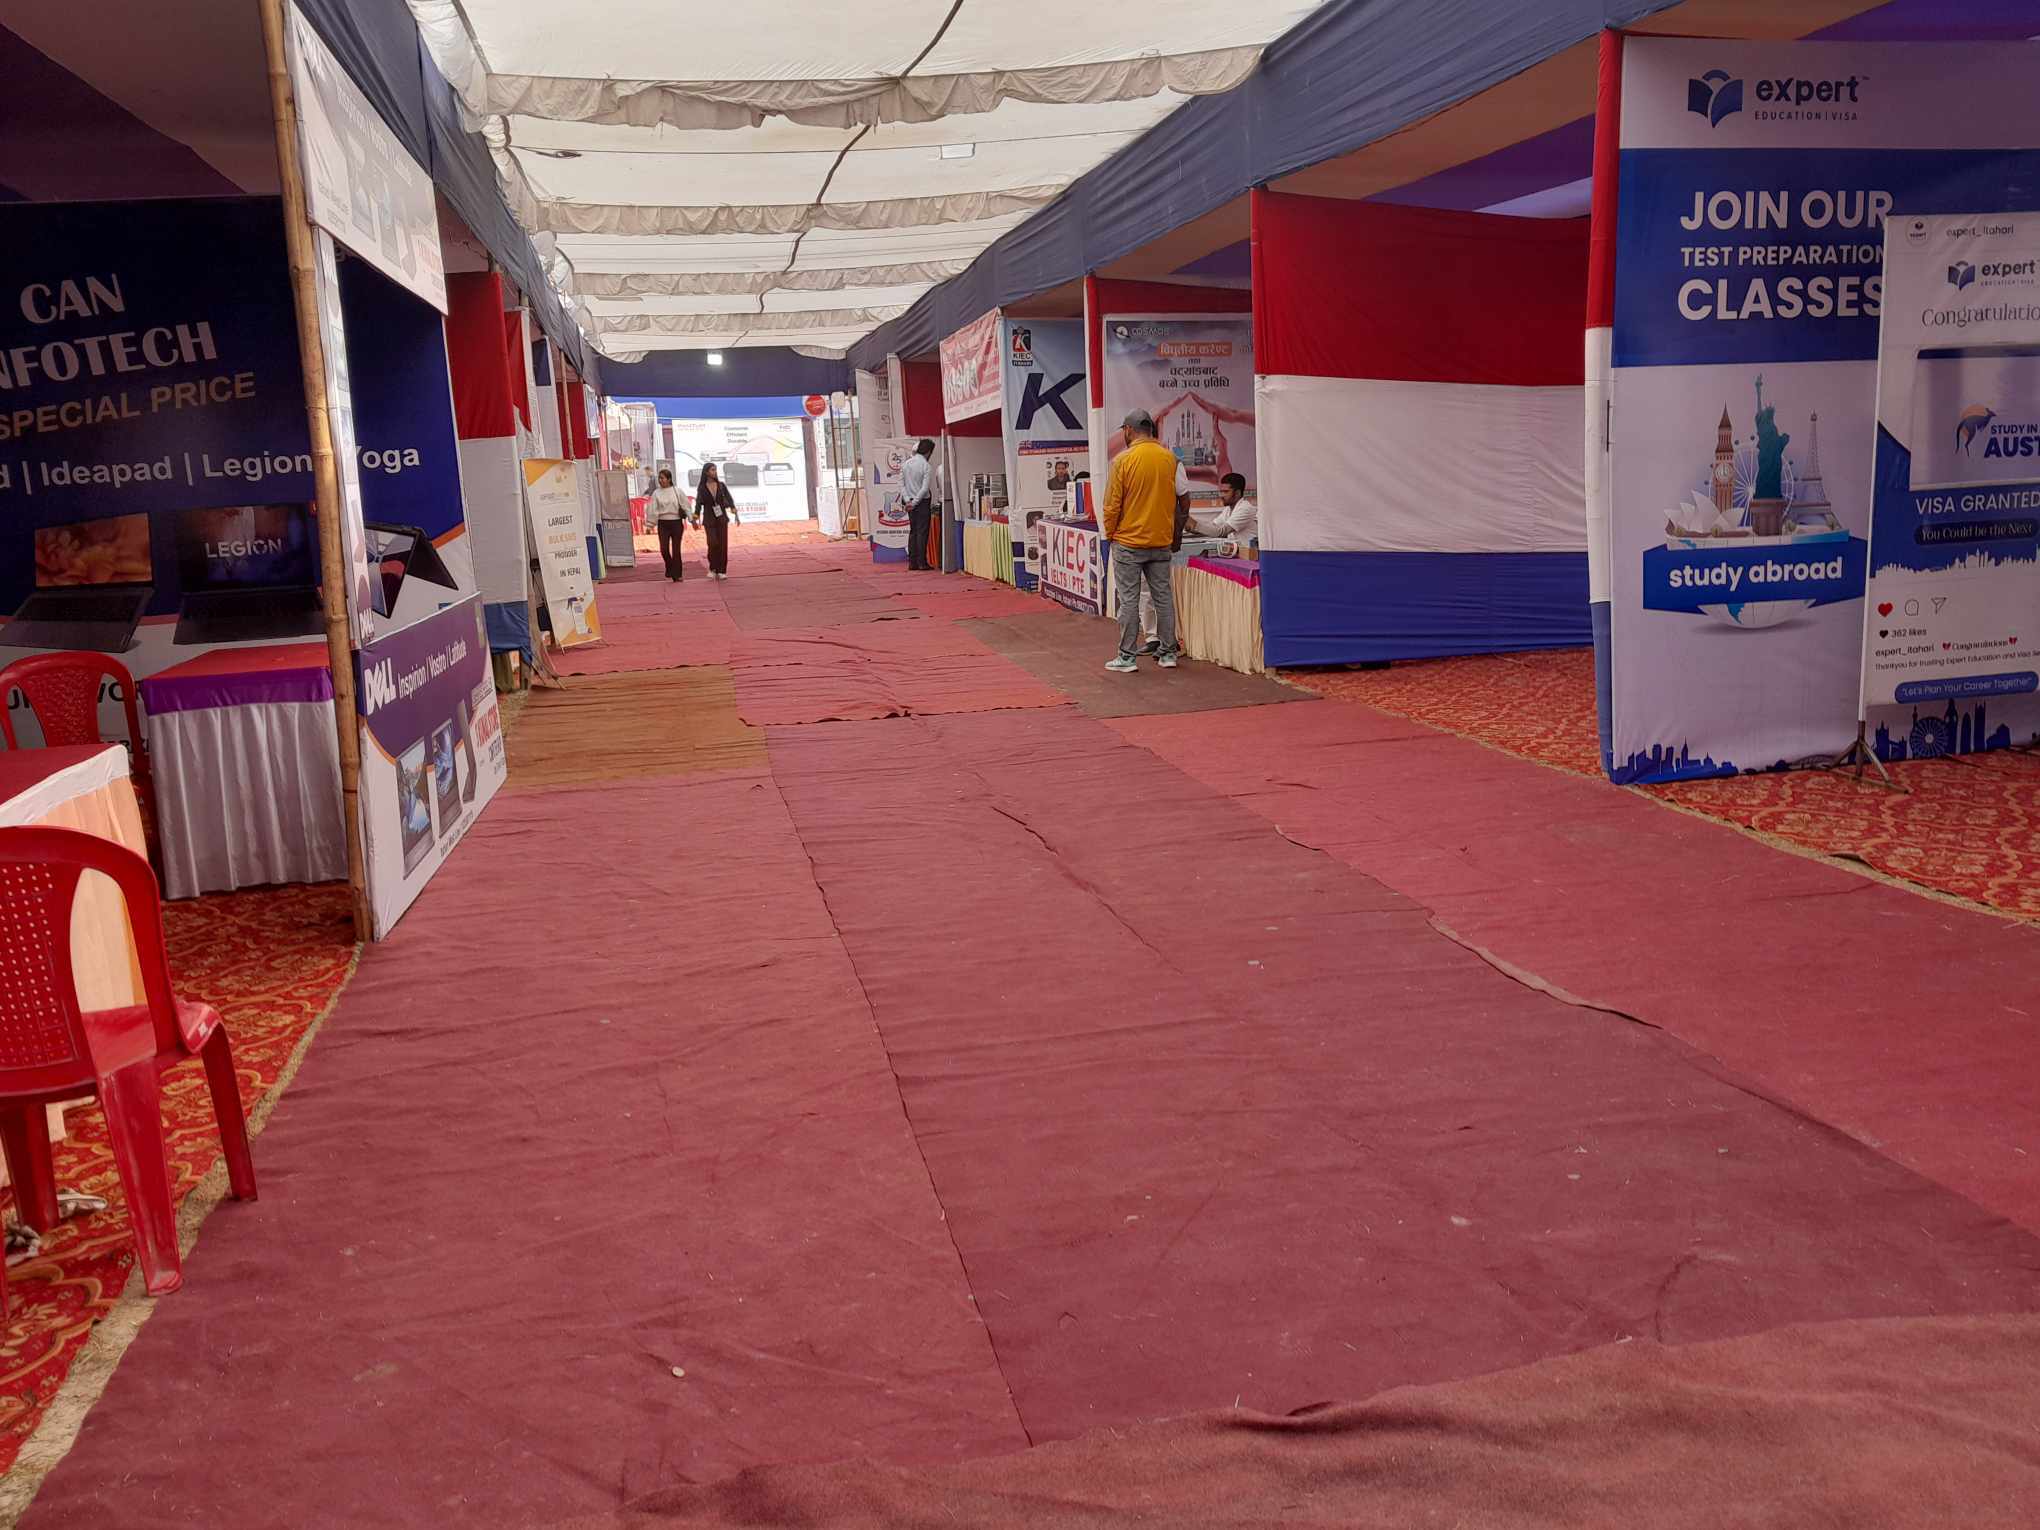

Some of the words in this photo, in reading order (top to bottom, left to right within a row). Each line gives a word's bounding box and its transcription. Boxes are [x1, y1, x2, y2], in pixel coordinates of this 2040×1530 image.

[1756, 75, 1859, 106] expert
[1754, 111, 1822, 121] EDUCATION
[1831, 111, 1858, 121] VISA
[1679, 190, 1789, 231] JOIN
[1800, 189, 1894, 229] OUR
[1680, 246, 1733, 267] TEST
[1981, 259, 2036, 277] expert
[19, 272, 126, 324] CAN
[1677, 275, 1882, 321] CLASSES
[1013, 352, 1031, 360] KIEC
[151, 371, 257, 413] PRICE
[1015, 373, 1087, 431] K
[1990, 423, 2025, 435] STUDY
[2026, 423, 2038, 434] IN
[40, 455, 173, 489] Ideapad
[202, 452, 313, 483] Legion
[1915, 496, 1956, 515] VISA
[1960, 491, 2040, 513] GRANTED
[205, 538, 282, 559] LEGION
[1052, 526, 1086, 574] KIEC
[1051, 567, 1068, 588] IELTS
[1072, 575, 1085, 595] PTE
[1669, 562, 1744, 593] study
[1748, 556, 1843, 584] abroad
[363, 657, 397, 716] DELL
